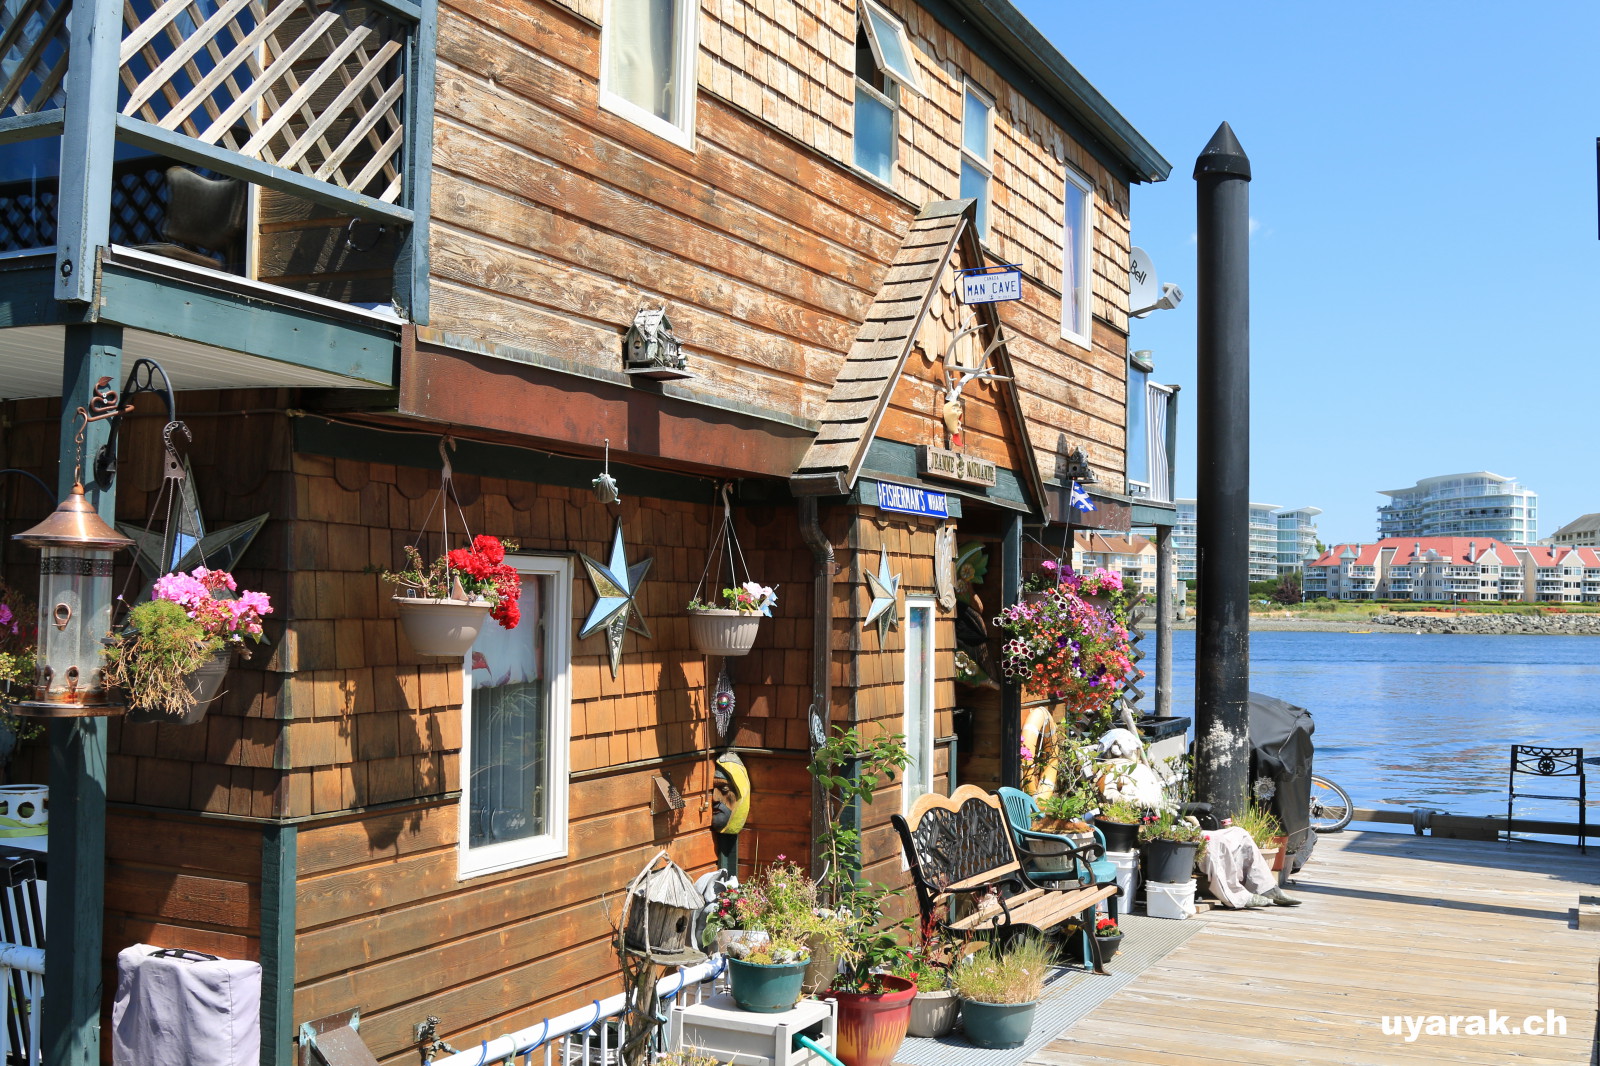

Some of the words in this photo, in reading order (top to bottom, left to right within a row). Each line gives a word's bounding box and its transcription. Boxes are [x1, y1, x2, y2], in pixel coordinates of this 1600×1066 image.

[1130, 259, 1147, 285] Bell
[967, 283, 986, 296] MAN
[992, 280, 1017, 294] CAVE
[931, 452, 955, 474] JEANNE
[881, 482, 926, 512] FISHERMAN'S
[927, 493, 945, 512] WHARF
